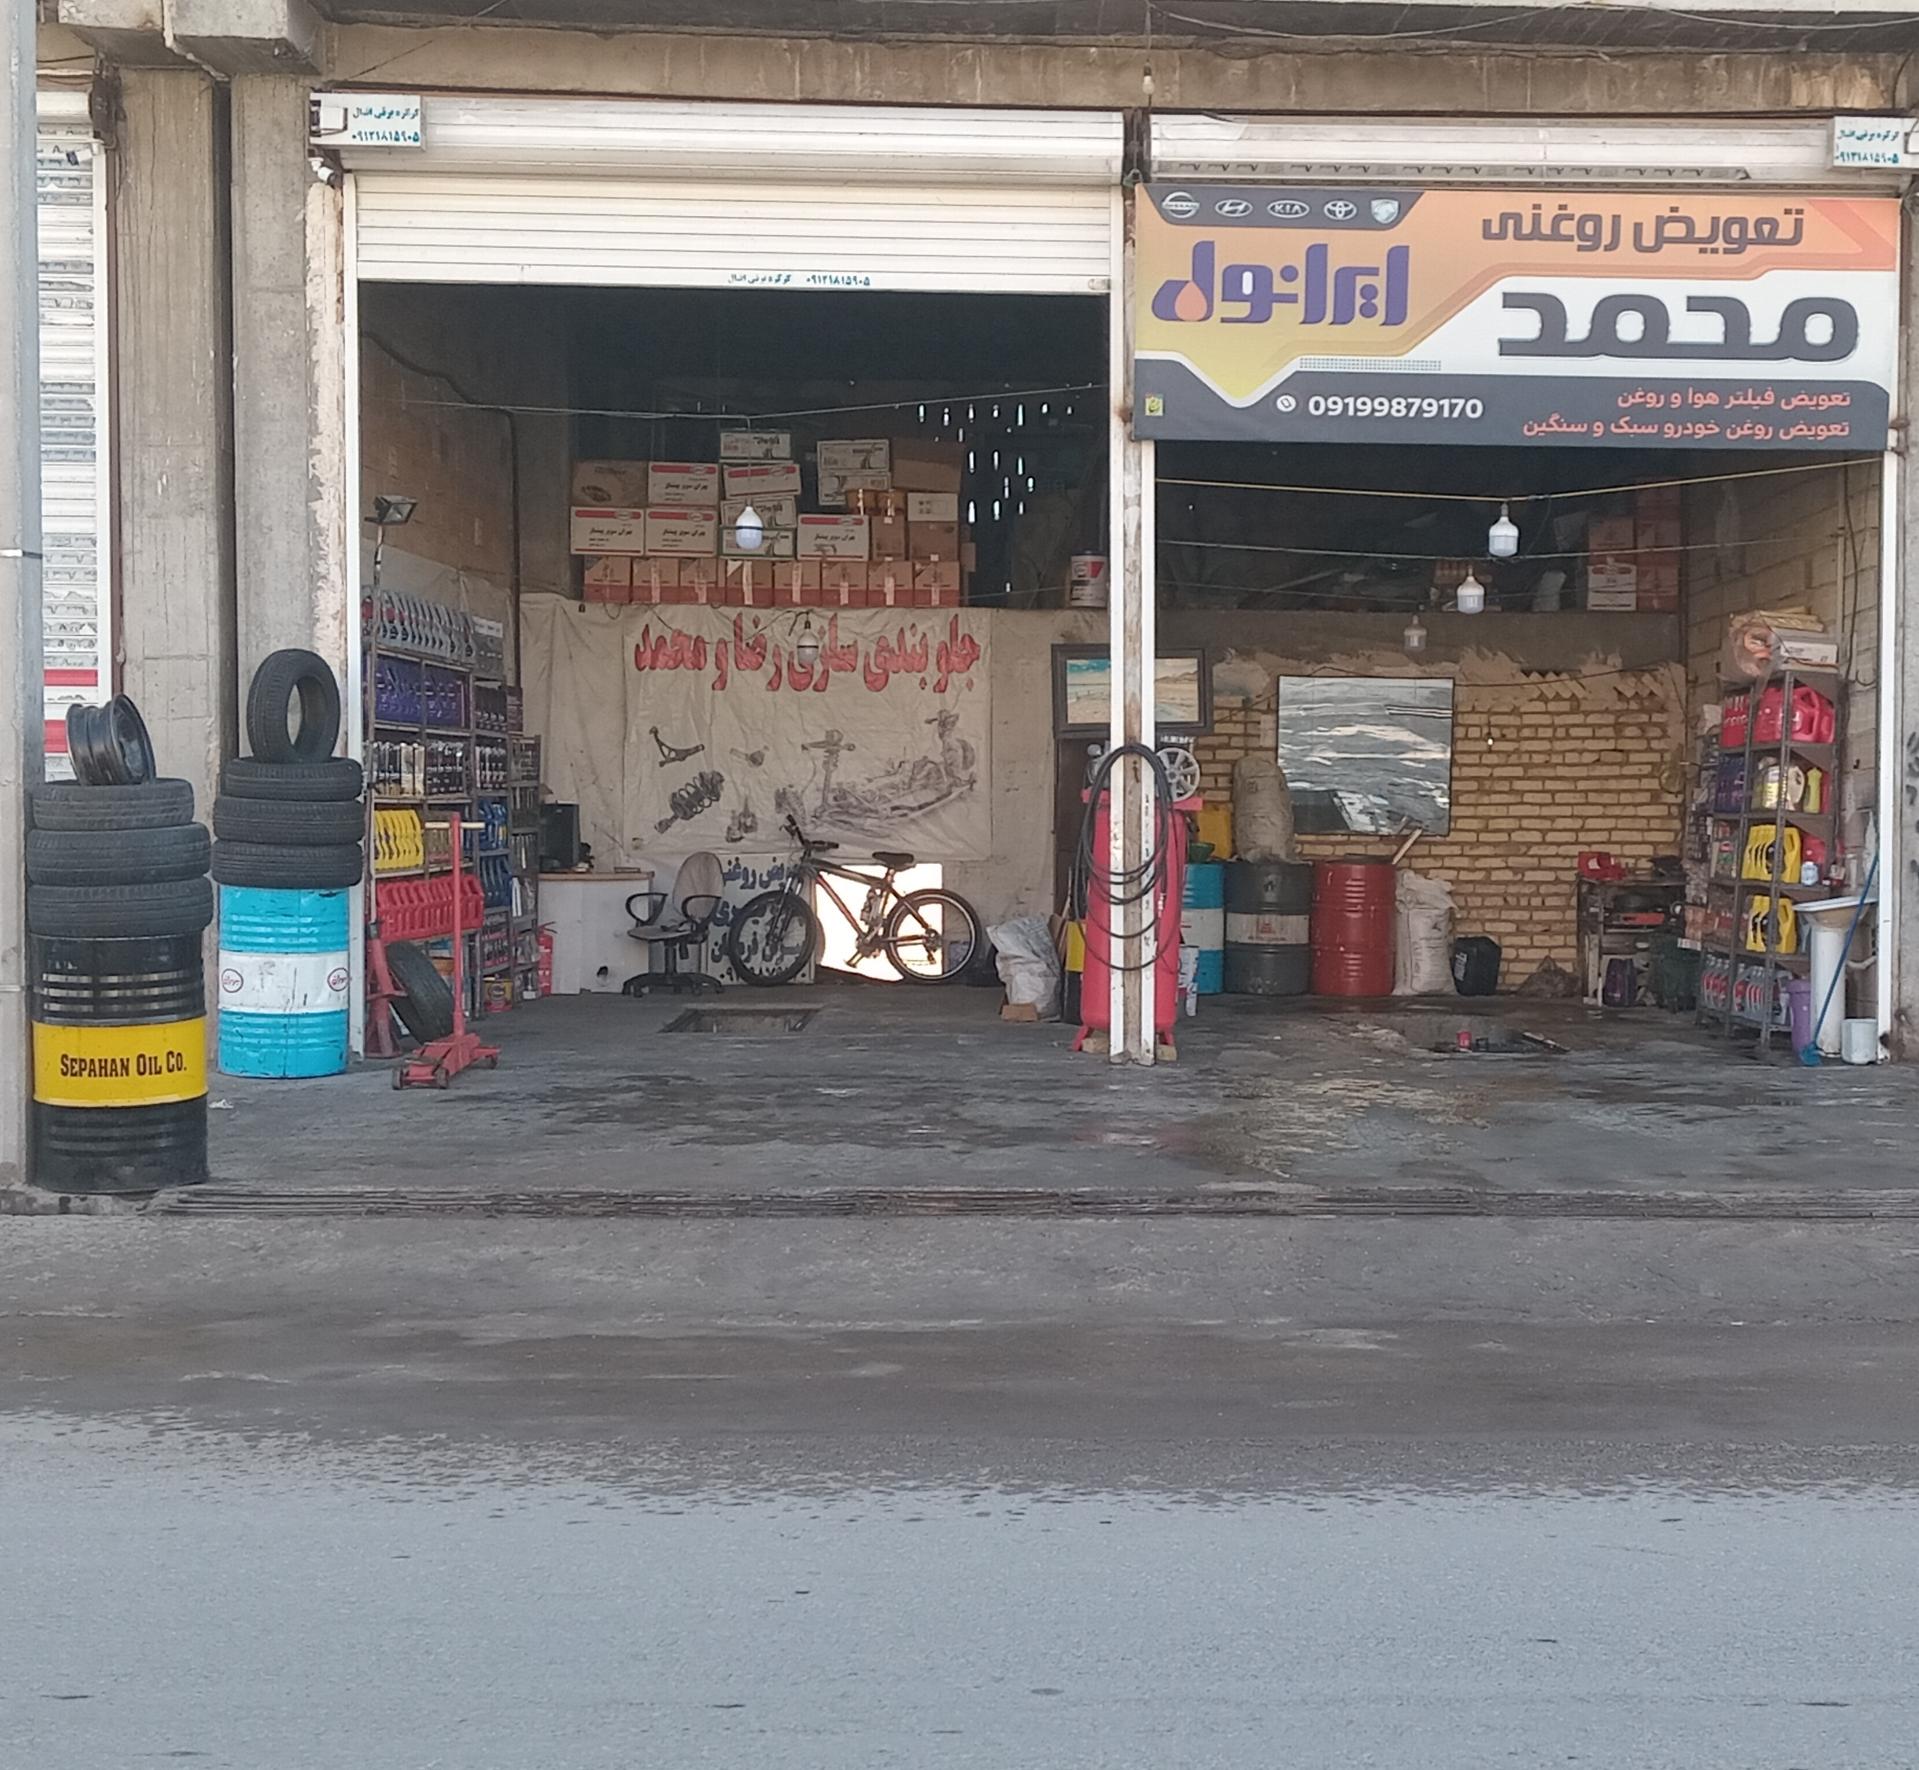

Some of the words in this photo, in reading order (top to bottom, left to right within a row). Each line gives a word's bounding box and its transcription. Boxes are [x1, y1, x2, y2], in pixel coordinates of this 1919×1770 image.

[1274, 204, 1302, 214] KIA
[1482, 203, 1622, 253] روغنی
[1633, 205, 1805, 254] تعویض
[1151, 240, 1410, 326] ایرانول
[1498, 291, 1860, 362] محمد
[1307, 395, 1484, 419] 09199879170
[1617, 386, 1665, 408] روغن
[1669, 391, 1682, 408] و
[1688, 386, 1720, 408] هوا
[1724, 386, 1776, 409] فیلتر
[1780, 389, 1851, 410] تعویض
[1522, 412, 1588, 437] سنگین
[1592, 420, 1605, 437] و
[1610, 415, 1659, 437] سبک
[1663, 419, 1721, 439] خودرو
[1725, 419, 1774, 439] روغن
[1778, 420, 1850, 440] تعویض
[634, 622, 707, 673] محمد
